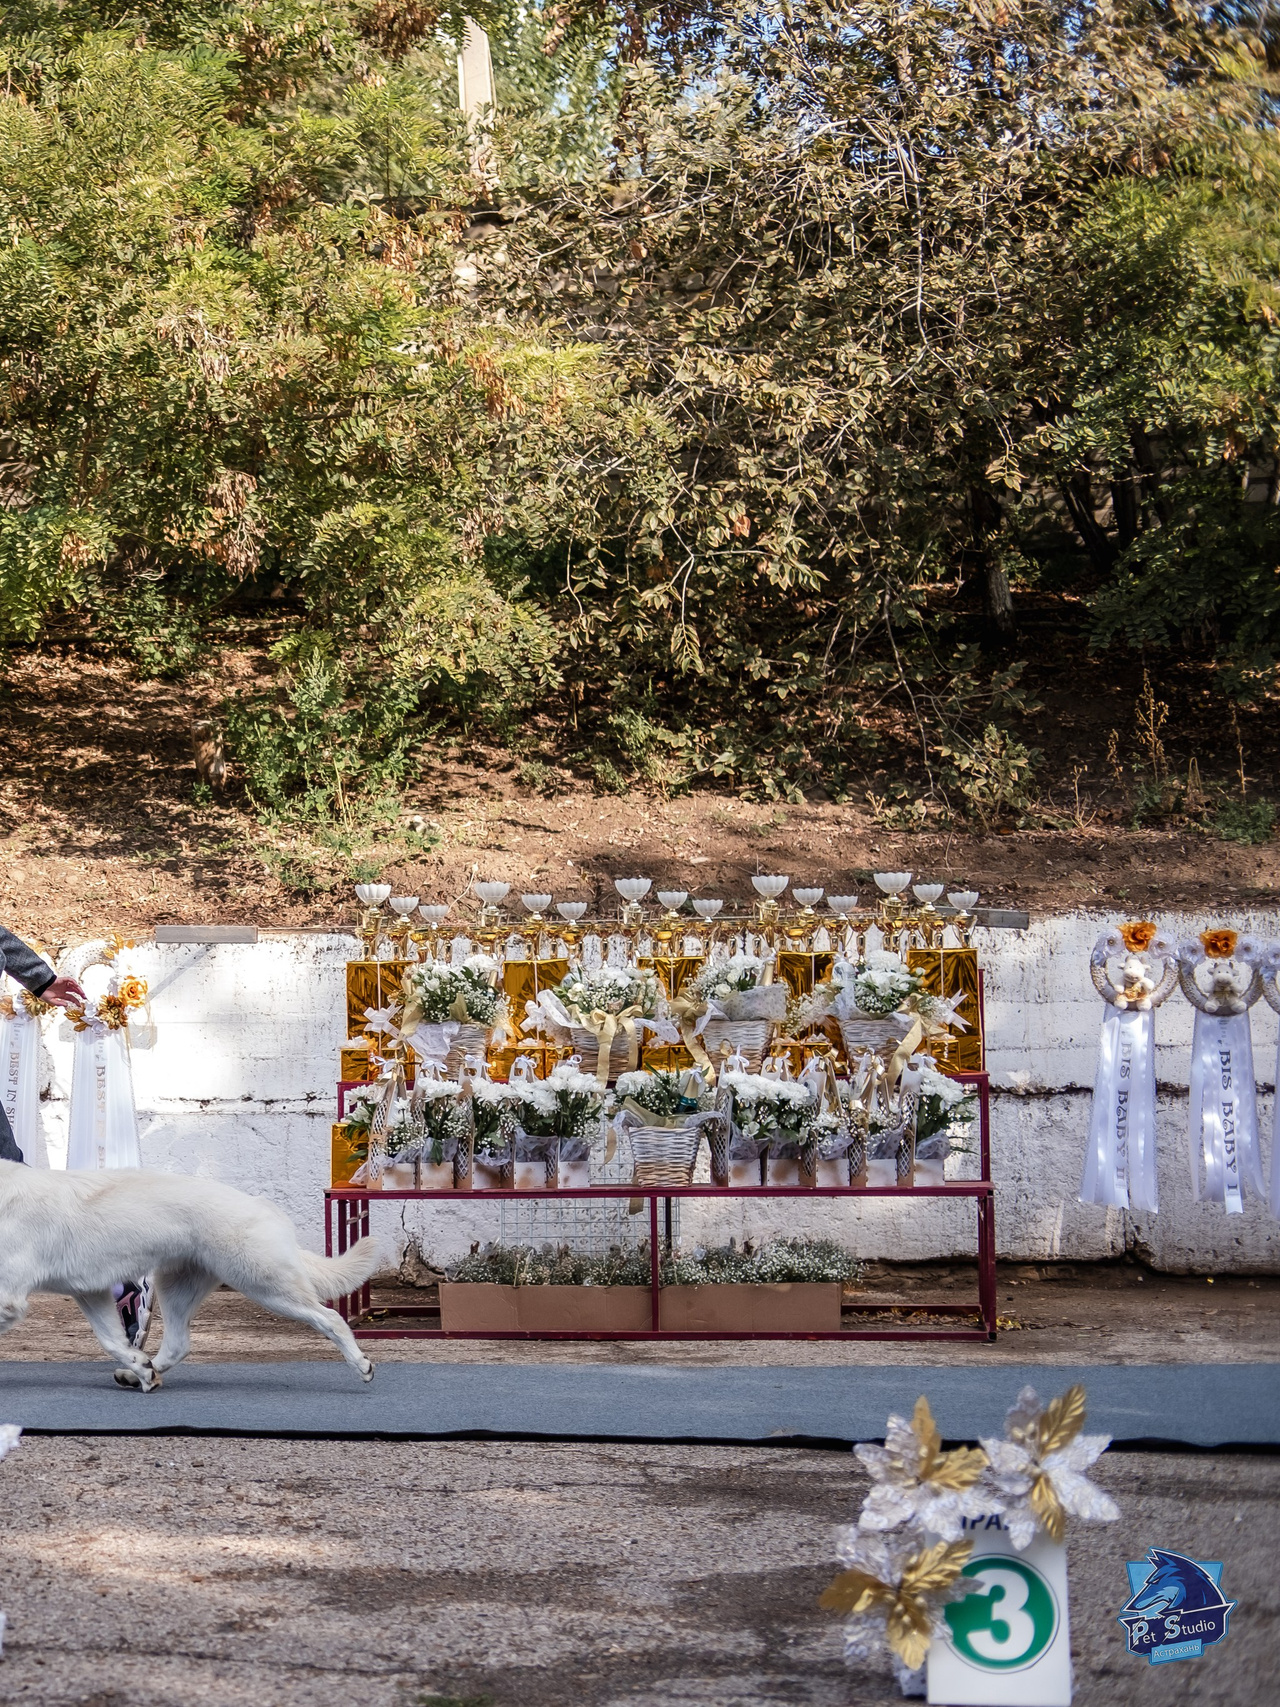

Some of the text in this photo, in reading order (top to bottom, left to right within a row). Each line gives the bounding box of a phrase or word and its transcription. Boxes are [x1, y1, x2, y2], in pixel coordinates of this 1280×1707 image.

[8, 1051, 20, 1086] BEST
[1120, 1042, 1132, 1079] BIS
[1219, 1049, 1233, 1091] BIS
[6, 1089, 17, 1103] IN
[96, 1065, 106, 1113] BEST
[1116, 1090, 1129, 1158] BABY
[1221, 1100, 1237, 1174] BABY
[1116, 1167, 1125, 1179] II
[966, 1568, 1035, 1661] 3
